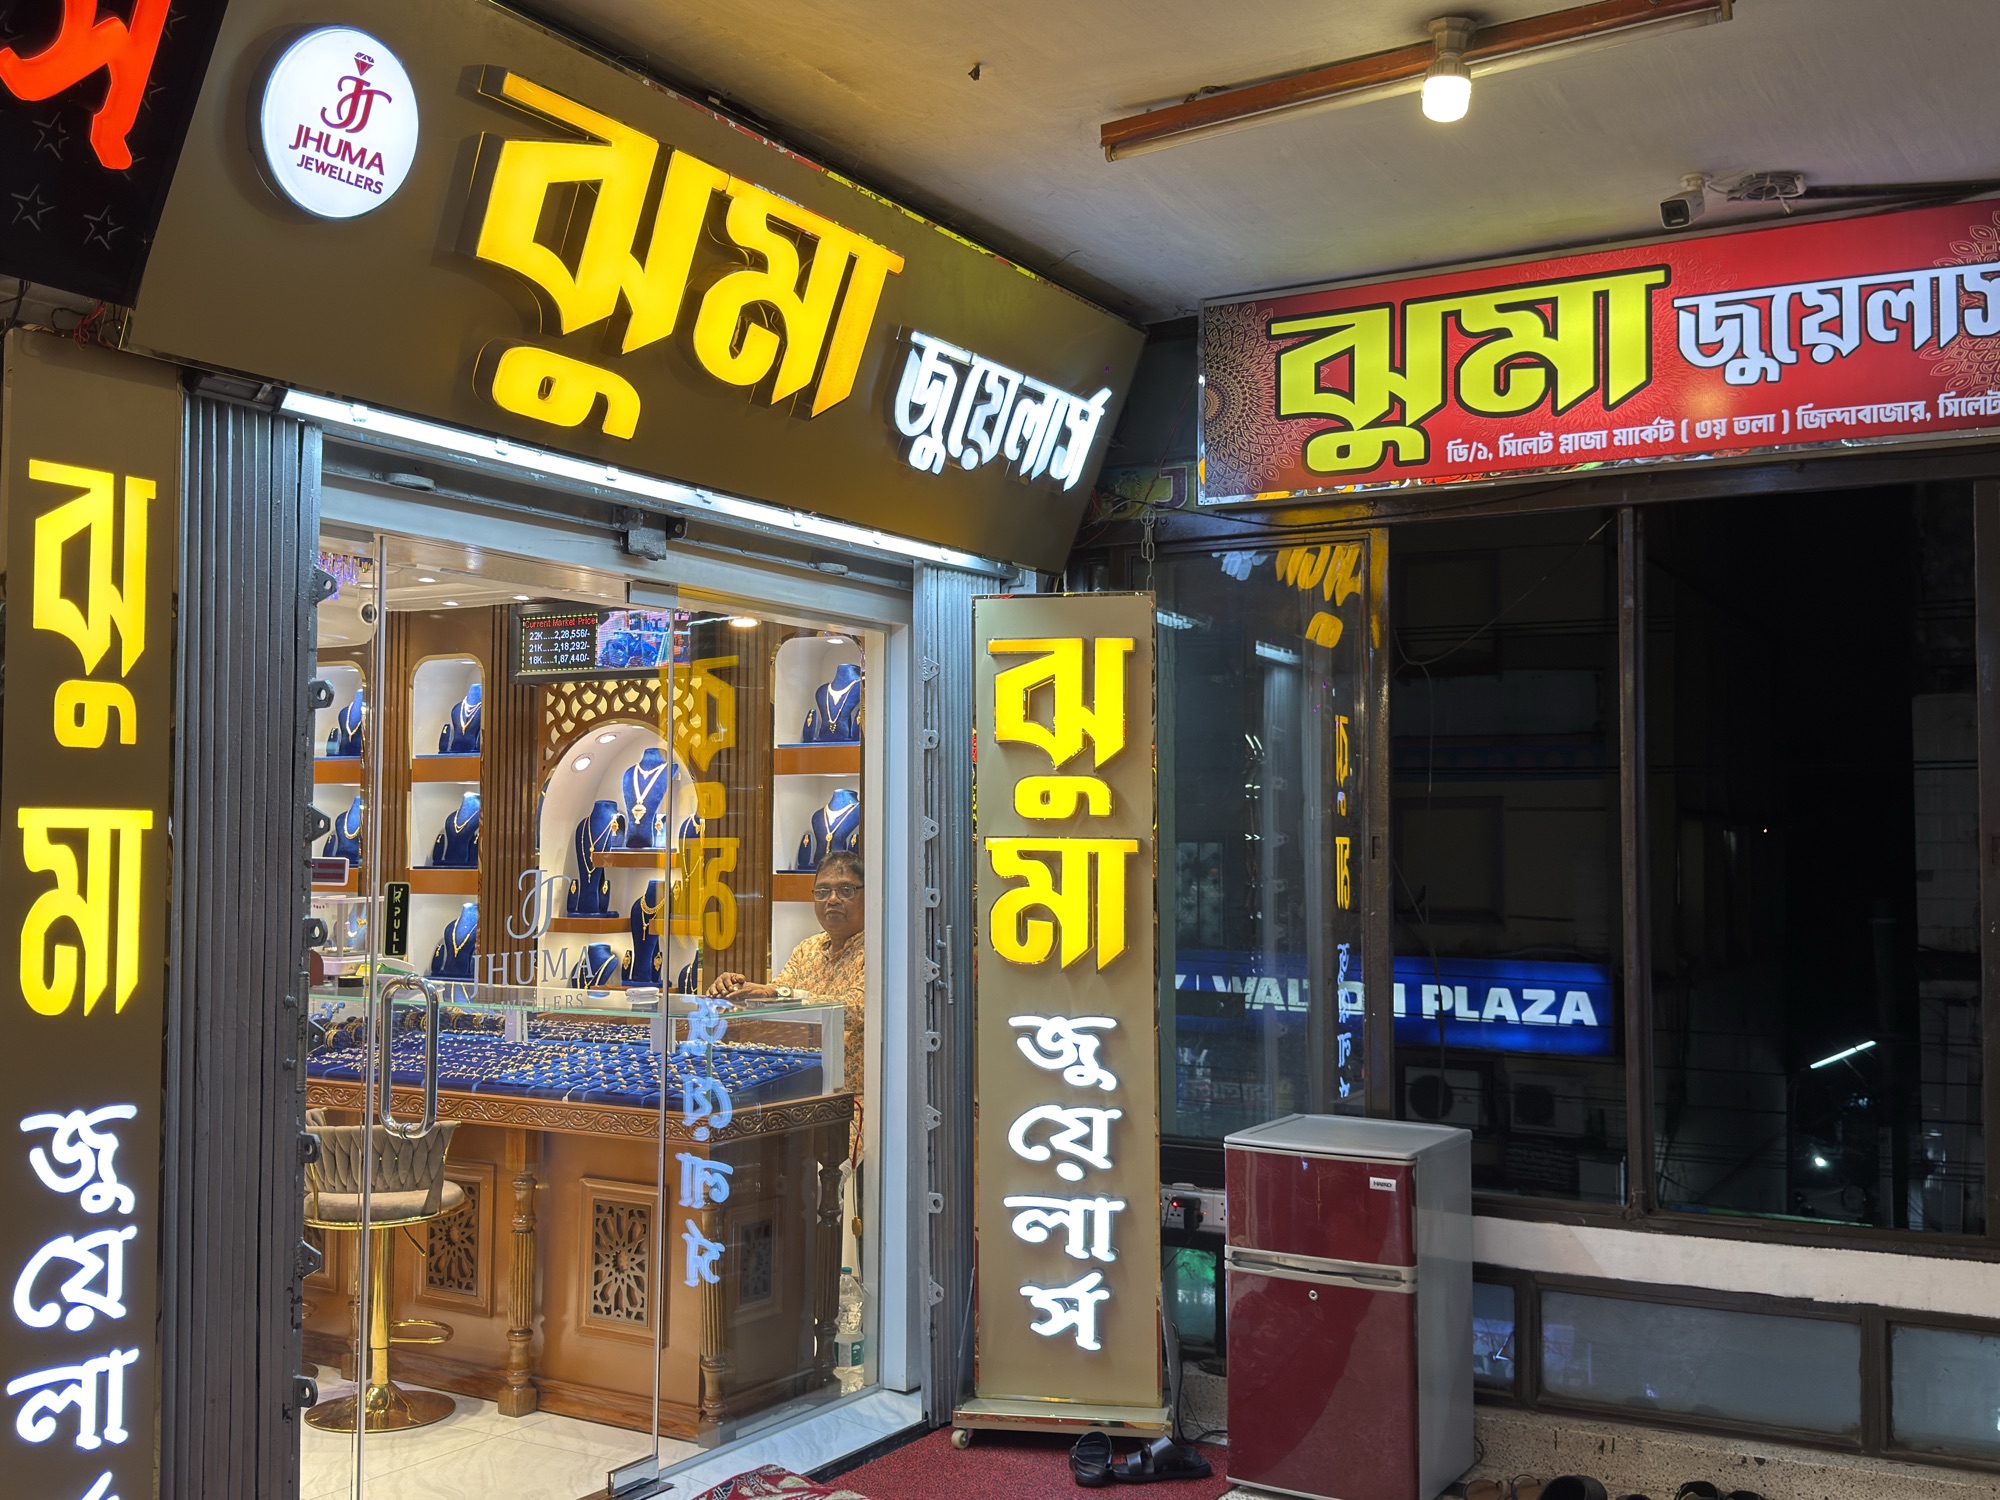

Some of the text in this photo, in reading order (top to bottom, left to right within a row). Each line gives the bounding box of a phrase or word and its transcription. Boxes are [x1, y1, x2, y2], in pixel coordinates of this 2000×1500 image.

[289, 124, 385, 175] JHUMA
[297, 155, 383, 194] JEWELLERS
[477, 71, 905, 440] ঝুমা
[894, 330, 1112, 492] জুয়েলার্স
[1269, 266, 1667, 475] ঝুমা
[1499, 432, 1553, 457] সিলেট
[1558, 432, 1607, 455] প্লাজা
[1614, 419, 1673, 446] মার্কেট
[525, 616, 597, 629] Current Market Price
[17, 459, 158, 1018] ঝুমা
[984, 637, 1140, 971] ঝুমা
[392, 906, 401, 954] PULL
[470, 945, 595, 998] JHUMA
[1421, 983, 1599, 1027] PLAZA
